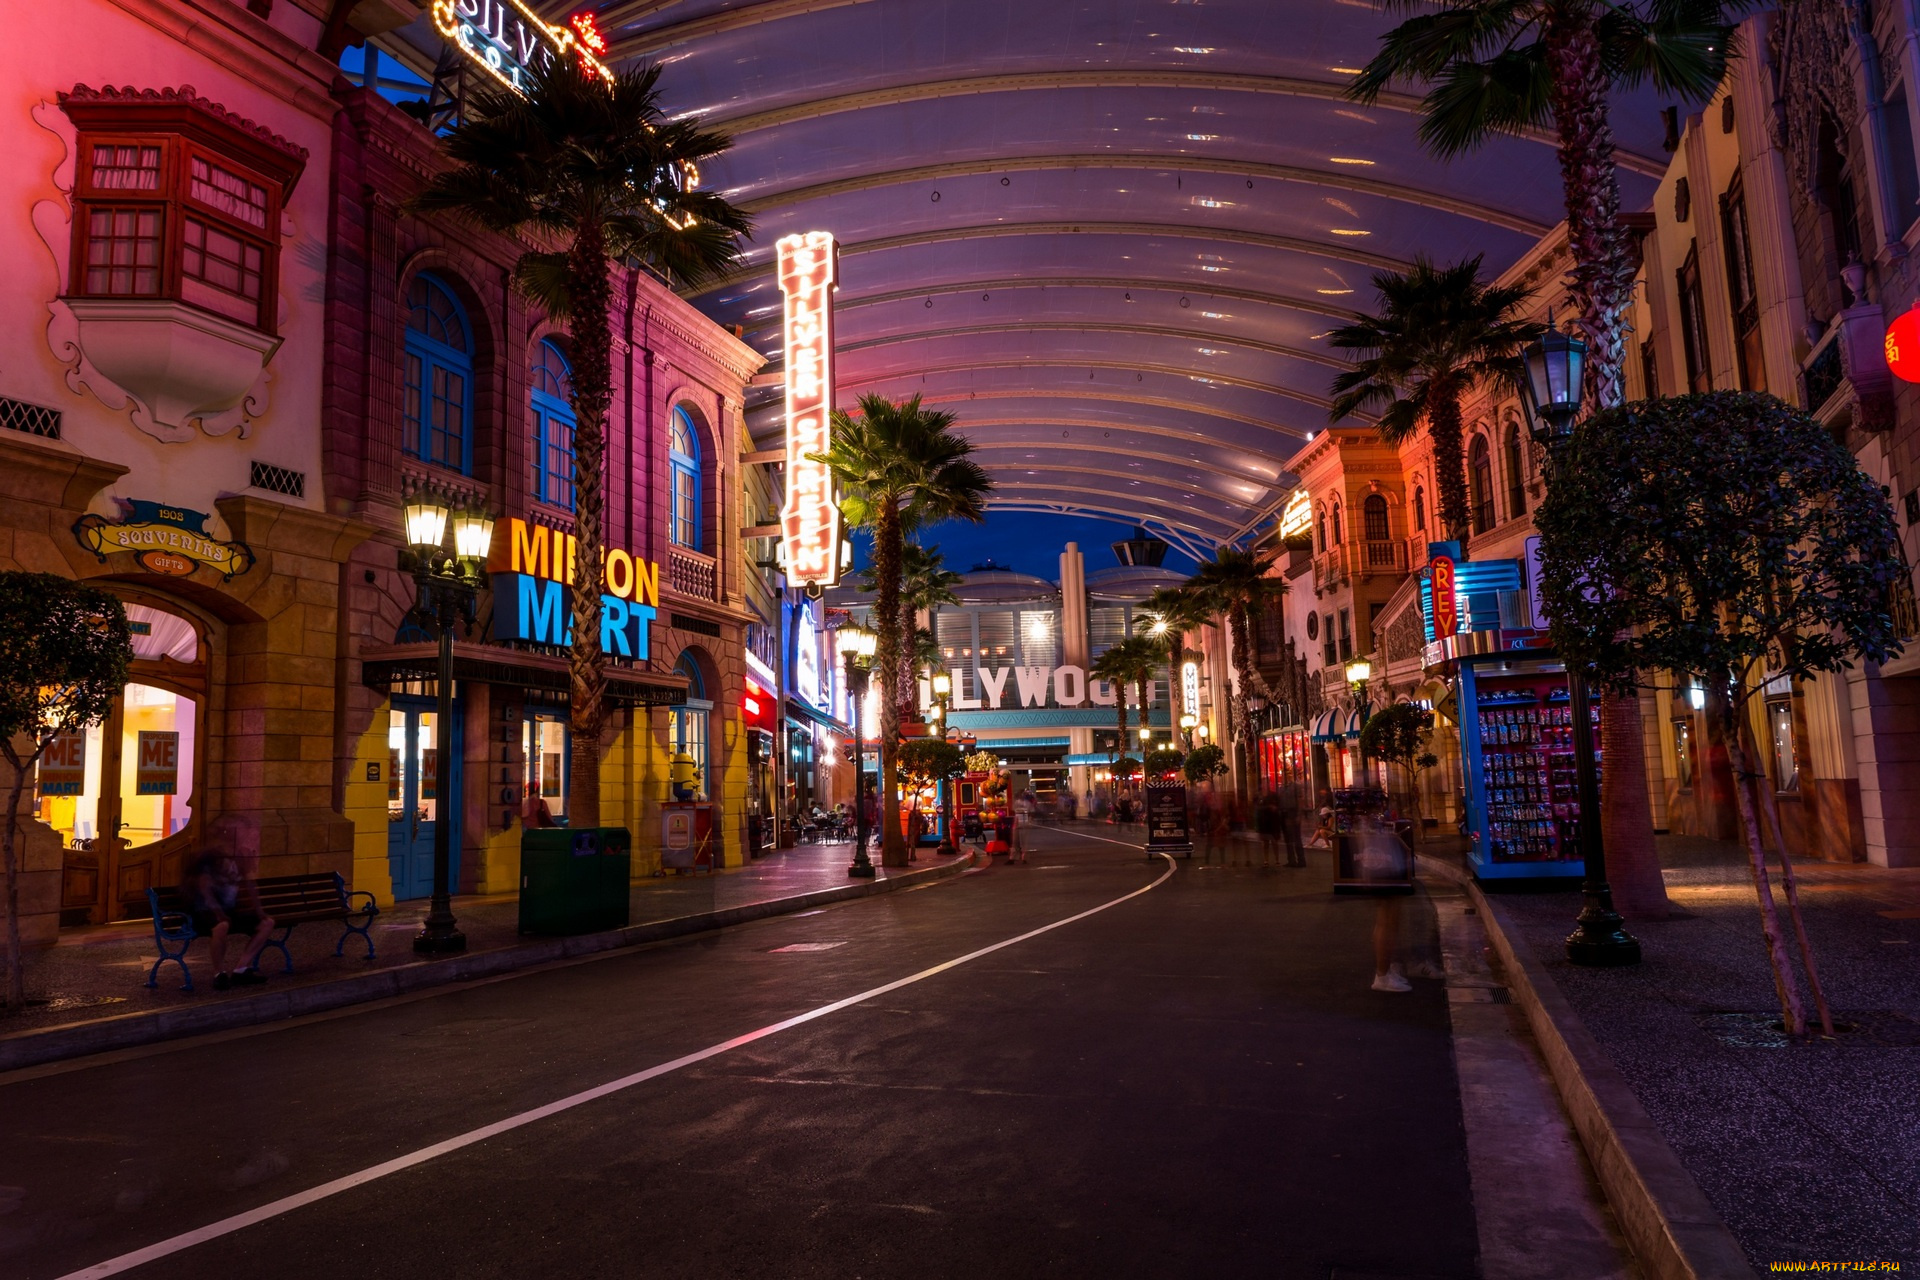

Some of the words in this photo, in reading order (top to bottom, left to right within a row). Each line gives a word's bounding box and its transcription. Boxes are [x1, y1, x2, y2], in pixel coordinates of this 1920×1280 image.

[158, 508, 184, 522] 1908
[118, 530, 224, 562] SOUVENIRS
[154, 557, 184, 570] GIFTS
[511, 517, 659, 608] MION
[1435, 567, 1453, 637] REY
[129, 624, 149, 633] ART
[518, 573, 657, 661] MRT
[44, 738, 82, 766] ME
[142, 741, 174, 767] ME
[42, 782, 80, 794] MART
[140, 782, 174, 793] MART
